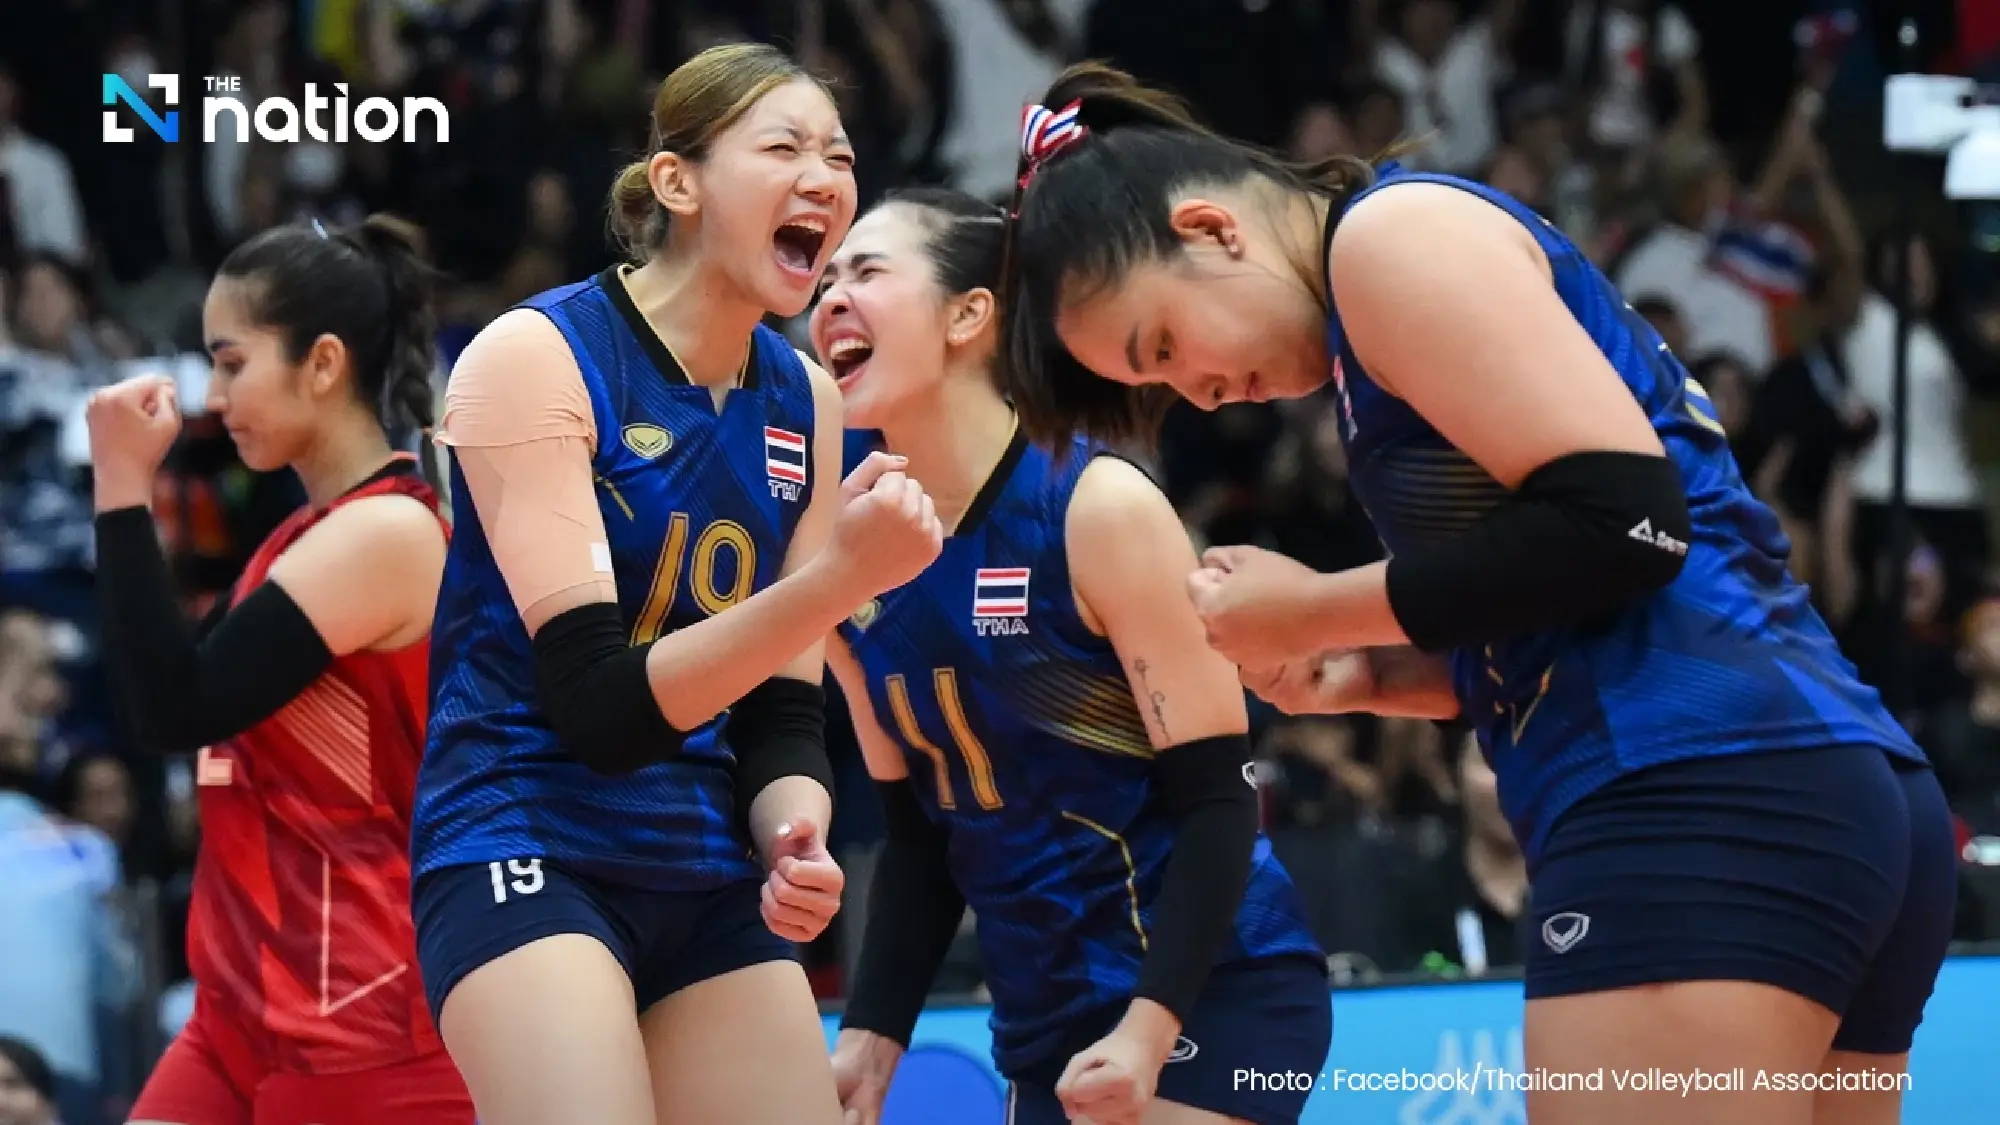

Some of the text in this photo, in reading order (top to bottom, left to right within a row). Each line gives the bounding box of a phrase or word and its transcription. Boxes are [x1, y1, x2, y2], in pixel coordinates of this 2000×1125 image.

[972, 618, 1030, 636] THA
[885, 667, 1004, 811] 11
[489, 858, 545, 903] 19
